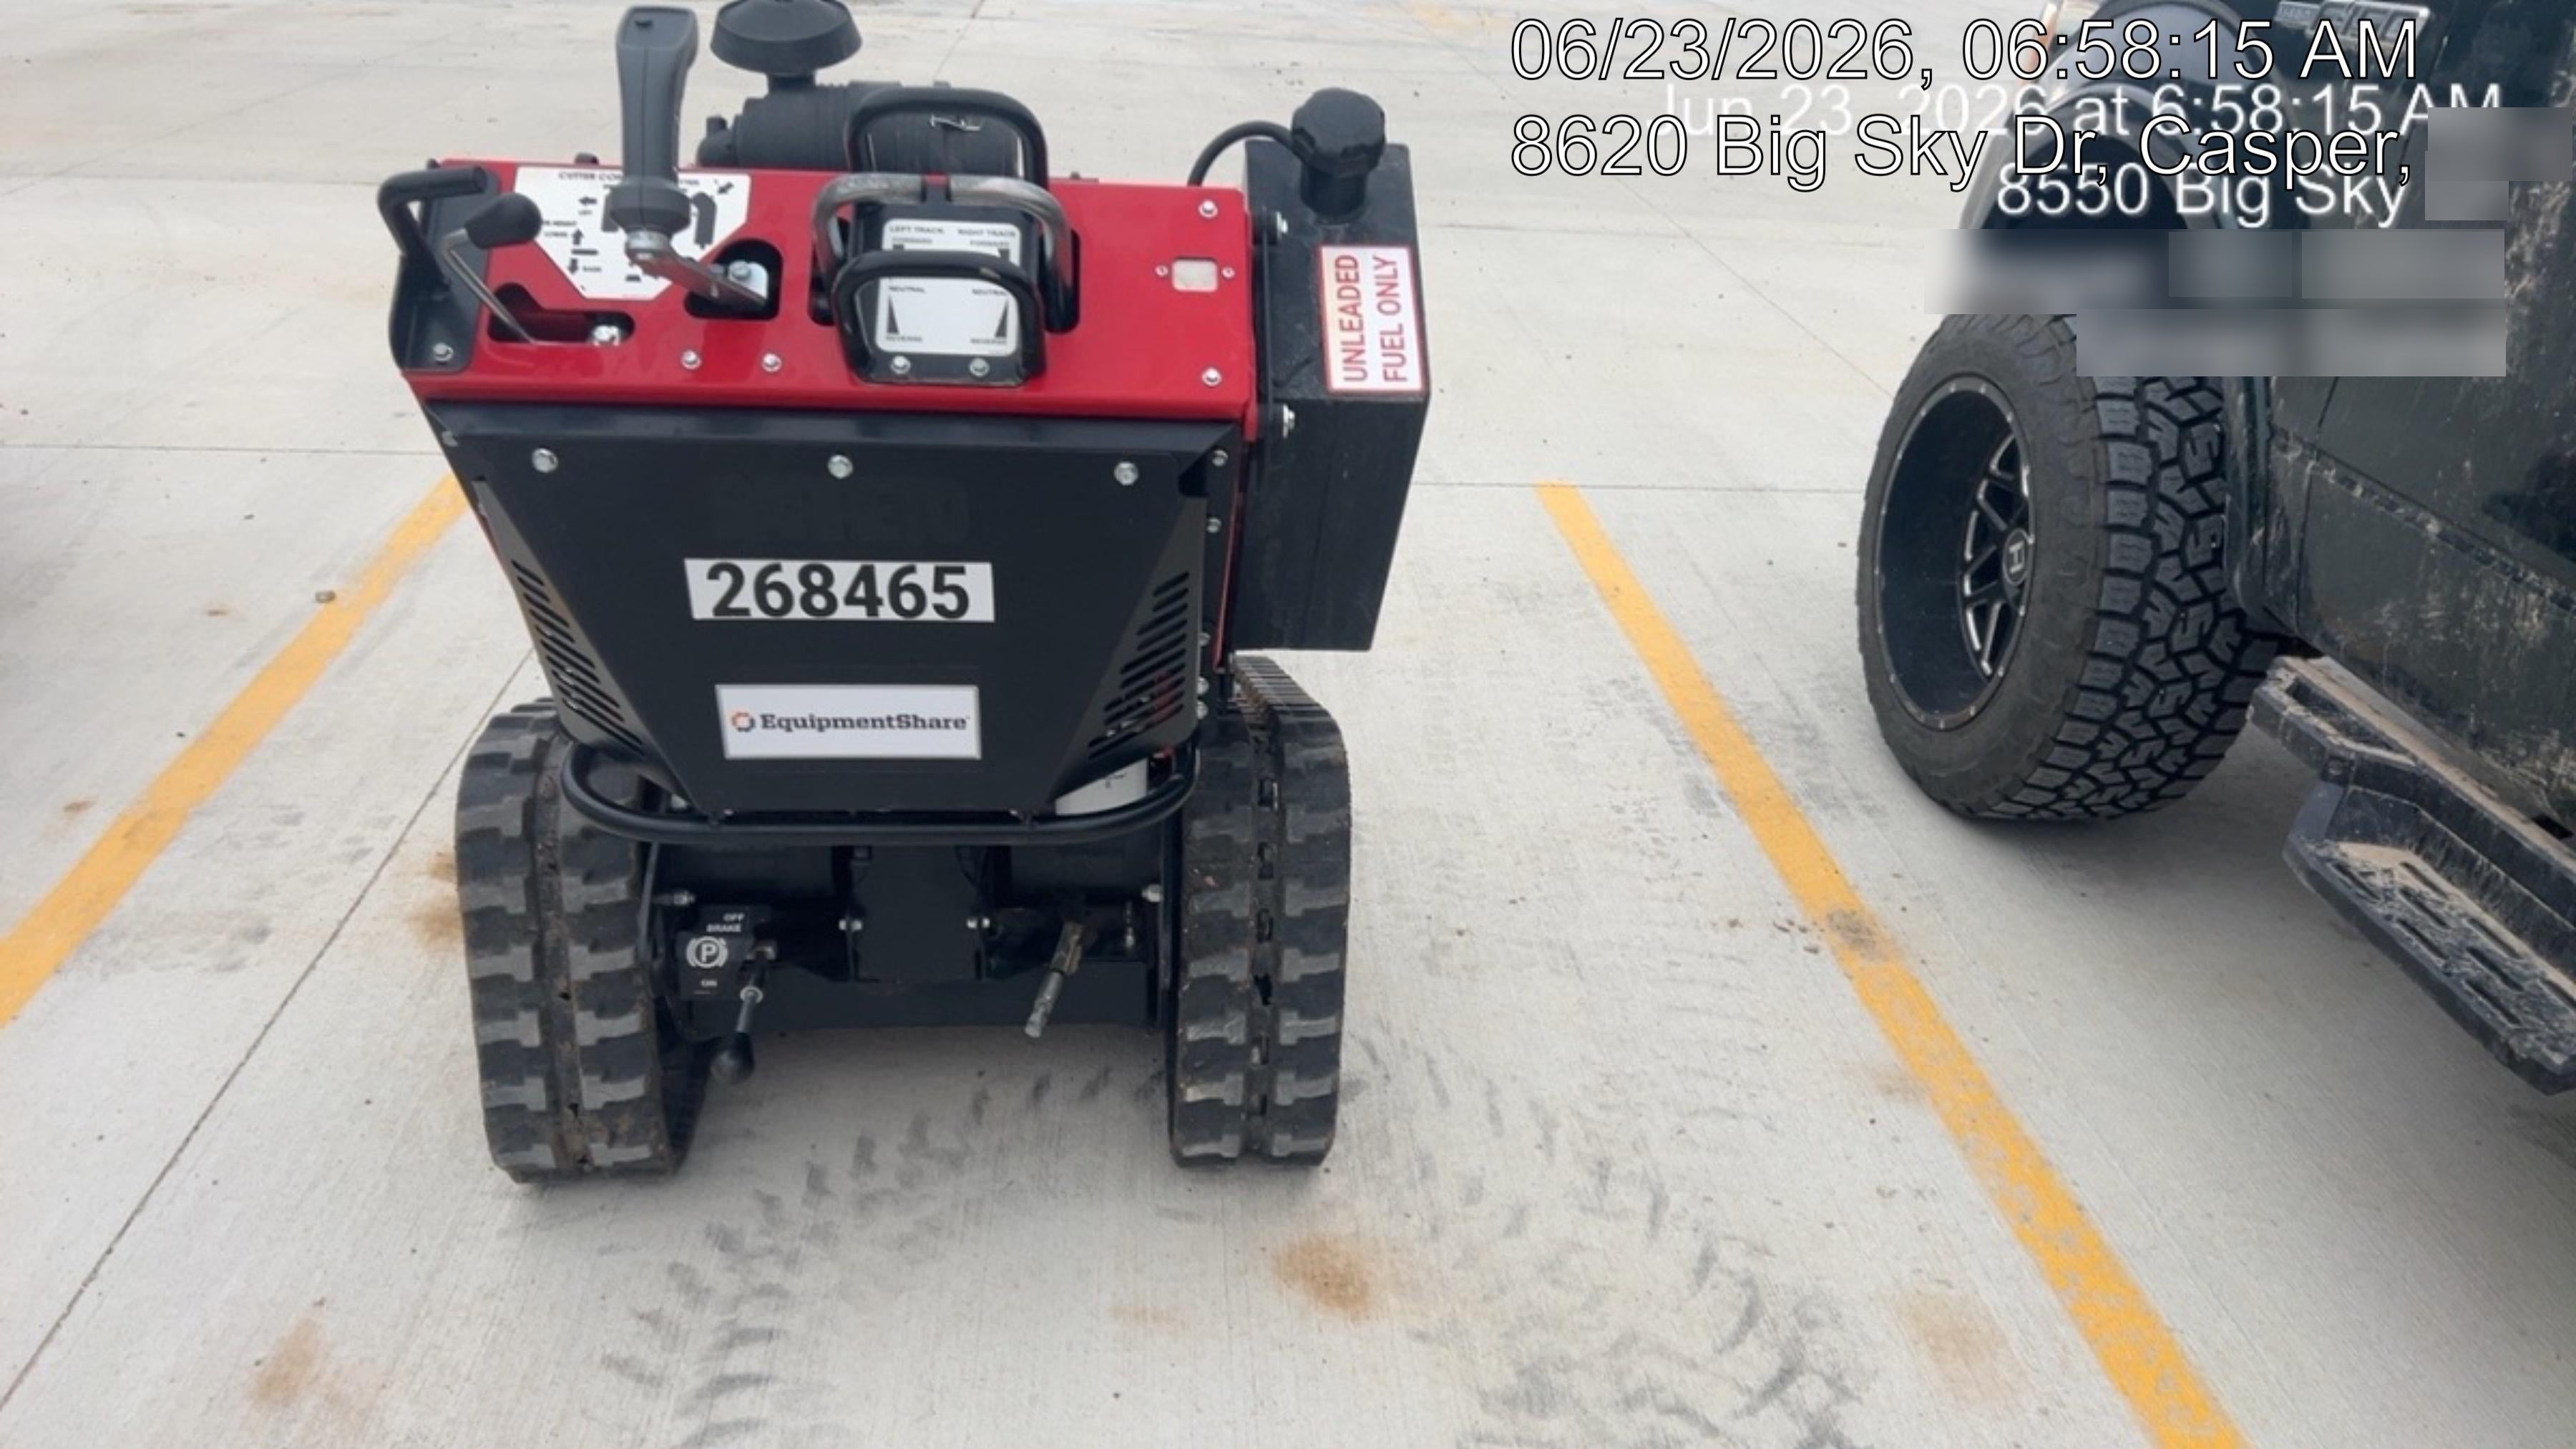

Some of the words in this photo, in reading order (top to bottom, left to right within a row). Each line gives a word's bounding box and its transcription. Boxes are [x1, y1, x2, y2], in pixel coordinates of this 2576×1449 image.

[1372, 255, 1402, 316] ONLY
[1335, 254, 1368, 383] UNLEADED
[1380, 323, 1407, 382] FUEL
[706, 561, 970, 620] 268465
[759, 713, 968, 733] EquipmentShare
